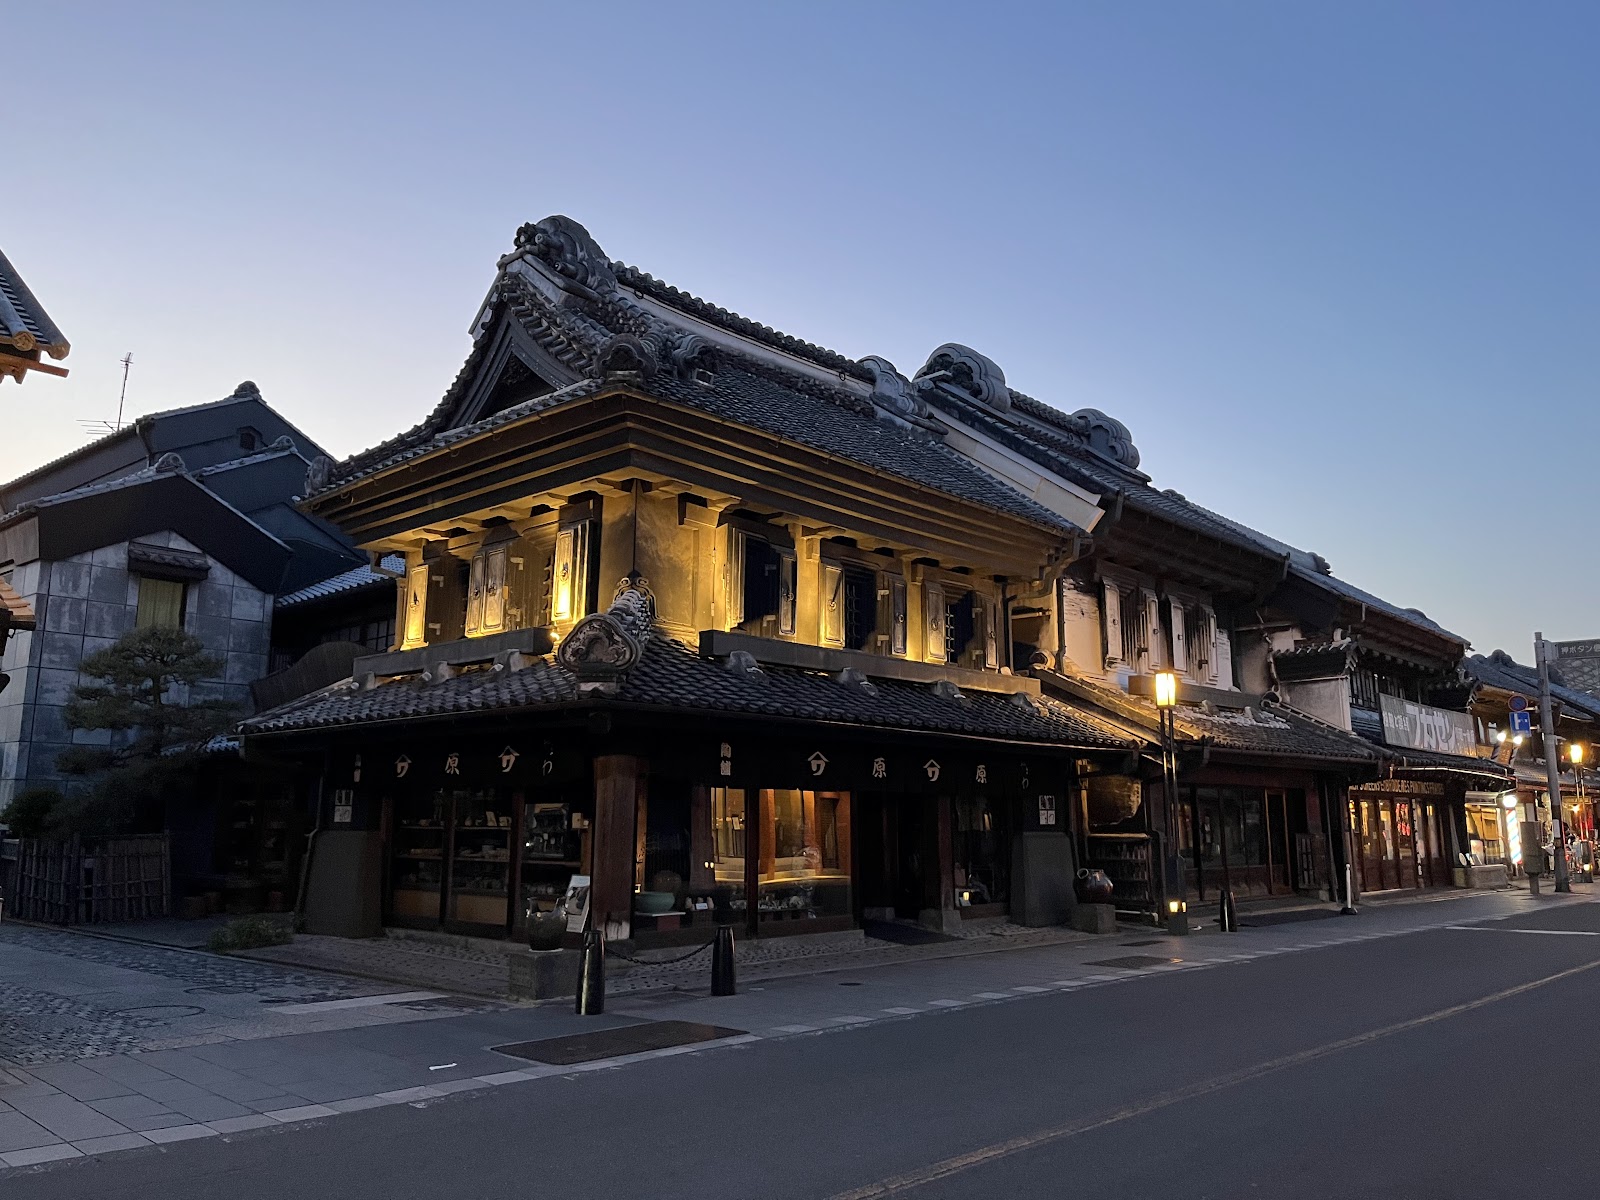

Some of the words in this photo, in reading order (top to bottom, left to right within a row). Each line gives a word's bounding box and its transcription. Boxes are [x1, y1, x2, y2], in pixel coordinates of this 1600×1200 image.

[445, 751, 460, 775] 原
[872, 757, 888, 779] 原
[976, 764, 988, 784] 原
